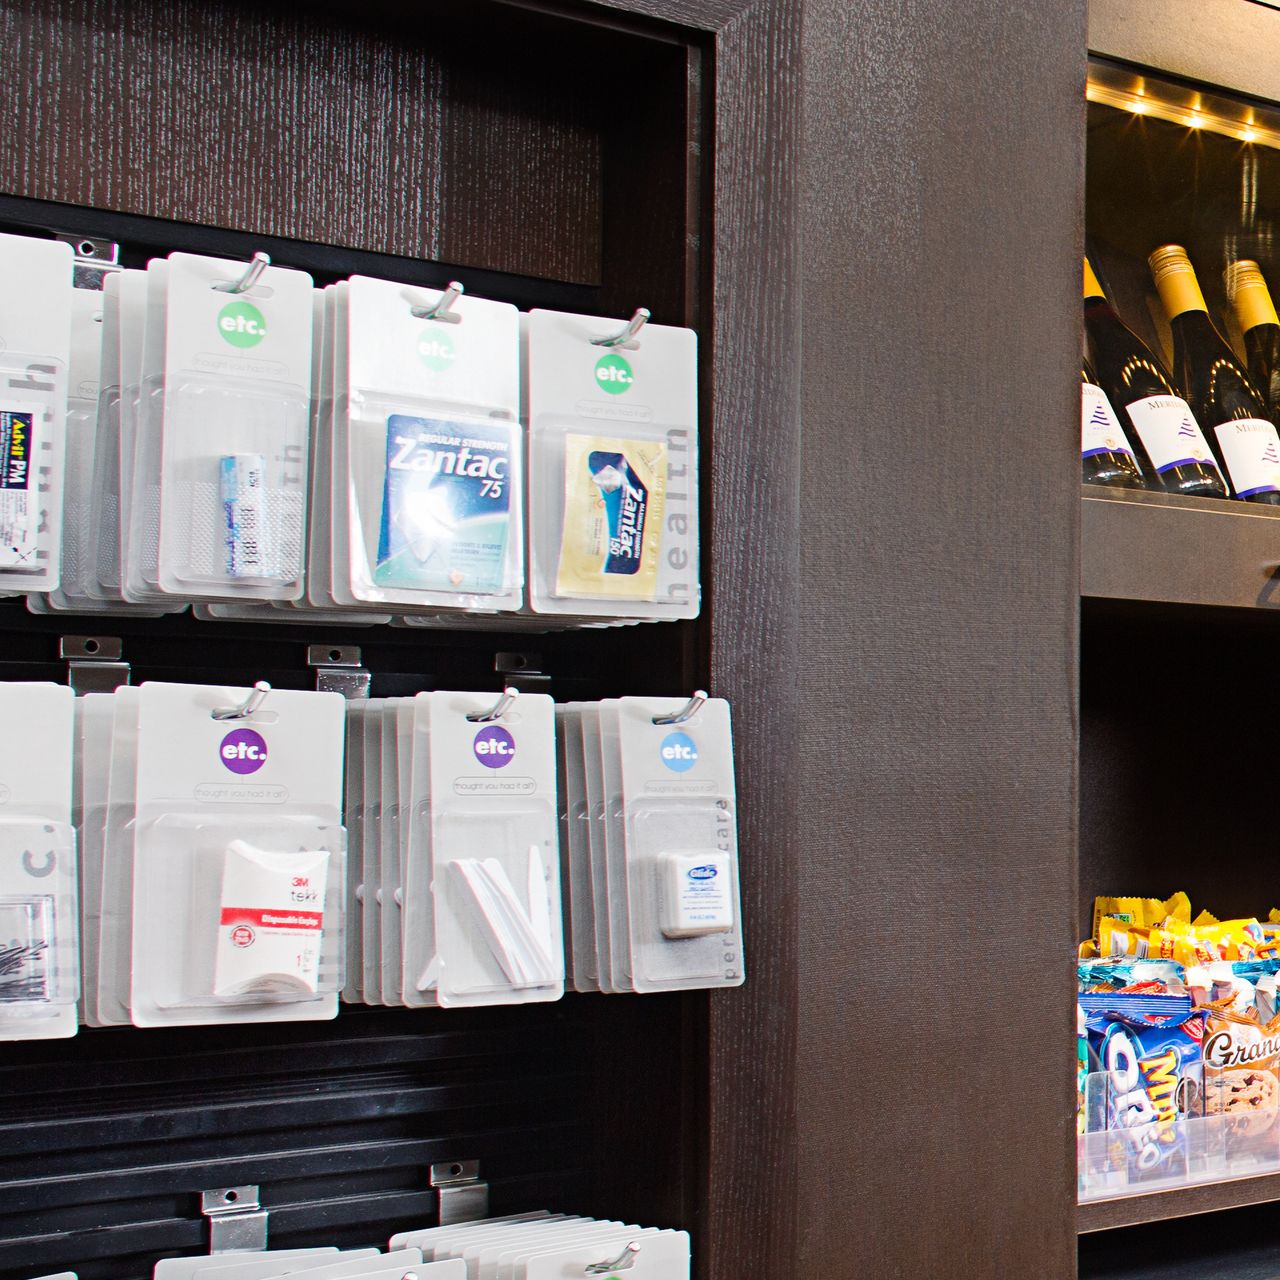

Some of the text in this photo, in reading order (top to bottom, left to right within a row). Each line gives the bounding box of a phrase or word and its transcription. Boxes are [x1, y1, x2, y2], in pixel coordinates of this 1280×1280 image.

[220, 315, 266, 336] etc.
[596, 366, 634, 384] etc.
[9, 418, 27, 484] Advil PM
[389, 436, 509, 480] Zantac
[479, 478, 503, 499] 75
[619, 486, 644, 559] Zantac
[222, 742, 267, 761] etc.
[475, 738, 516, 757] etc.
[662, 743, 698, 761] etc.
[1101, 1022, 1162, 1170] OREO
